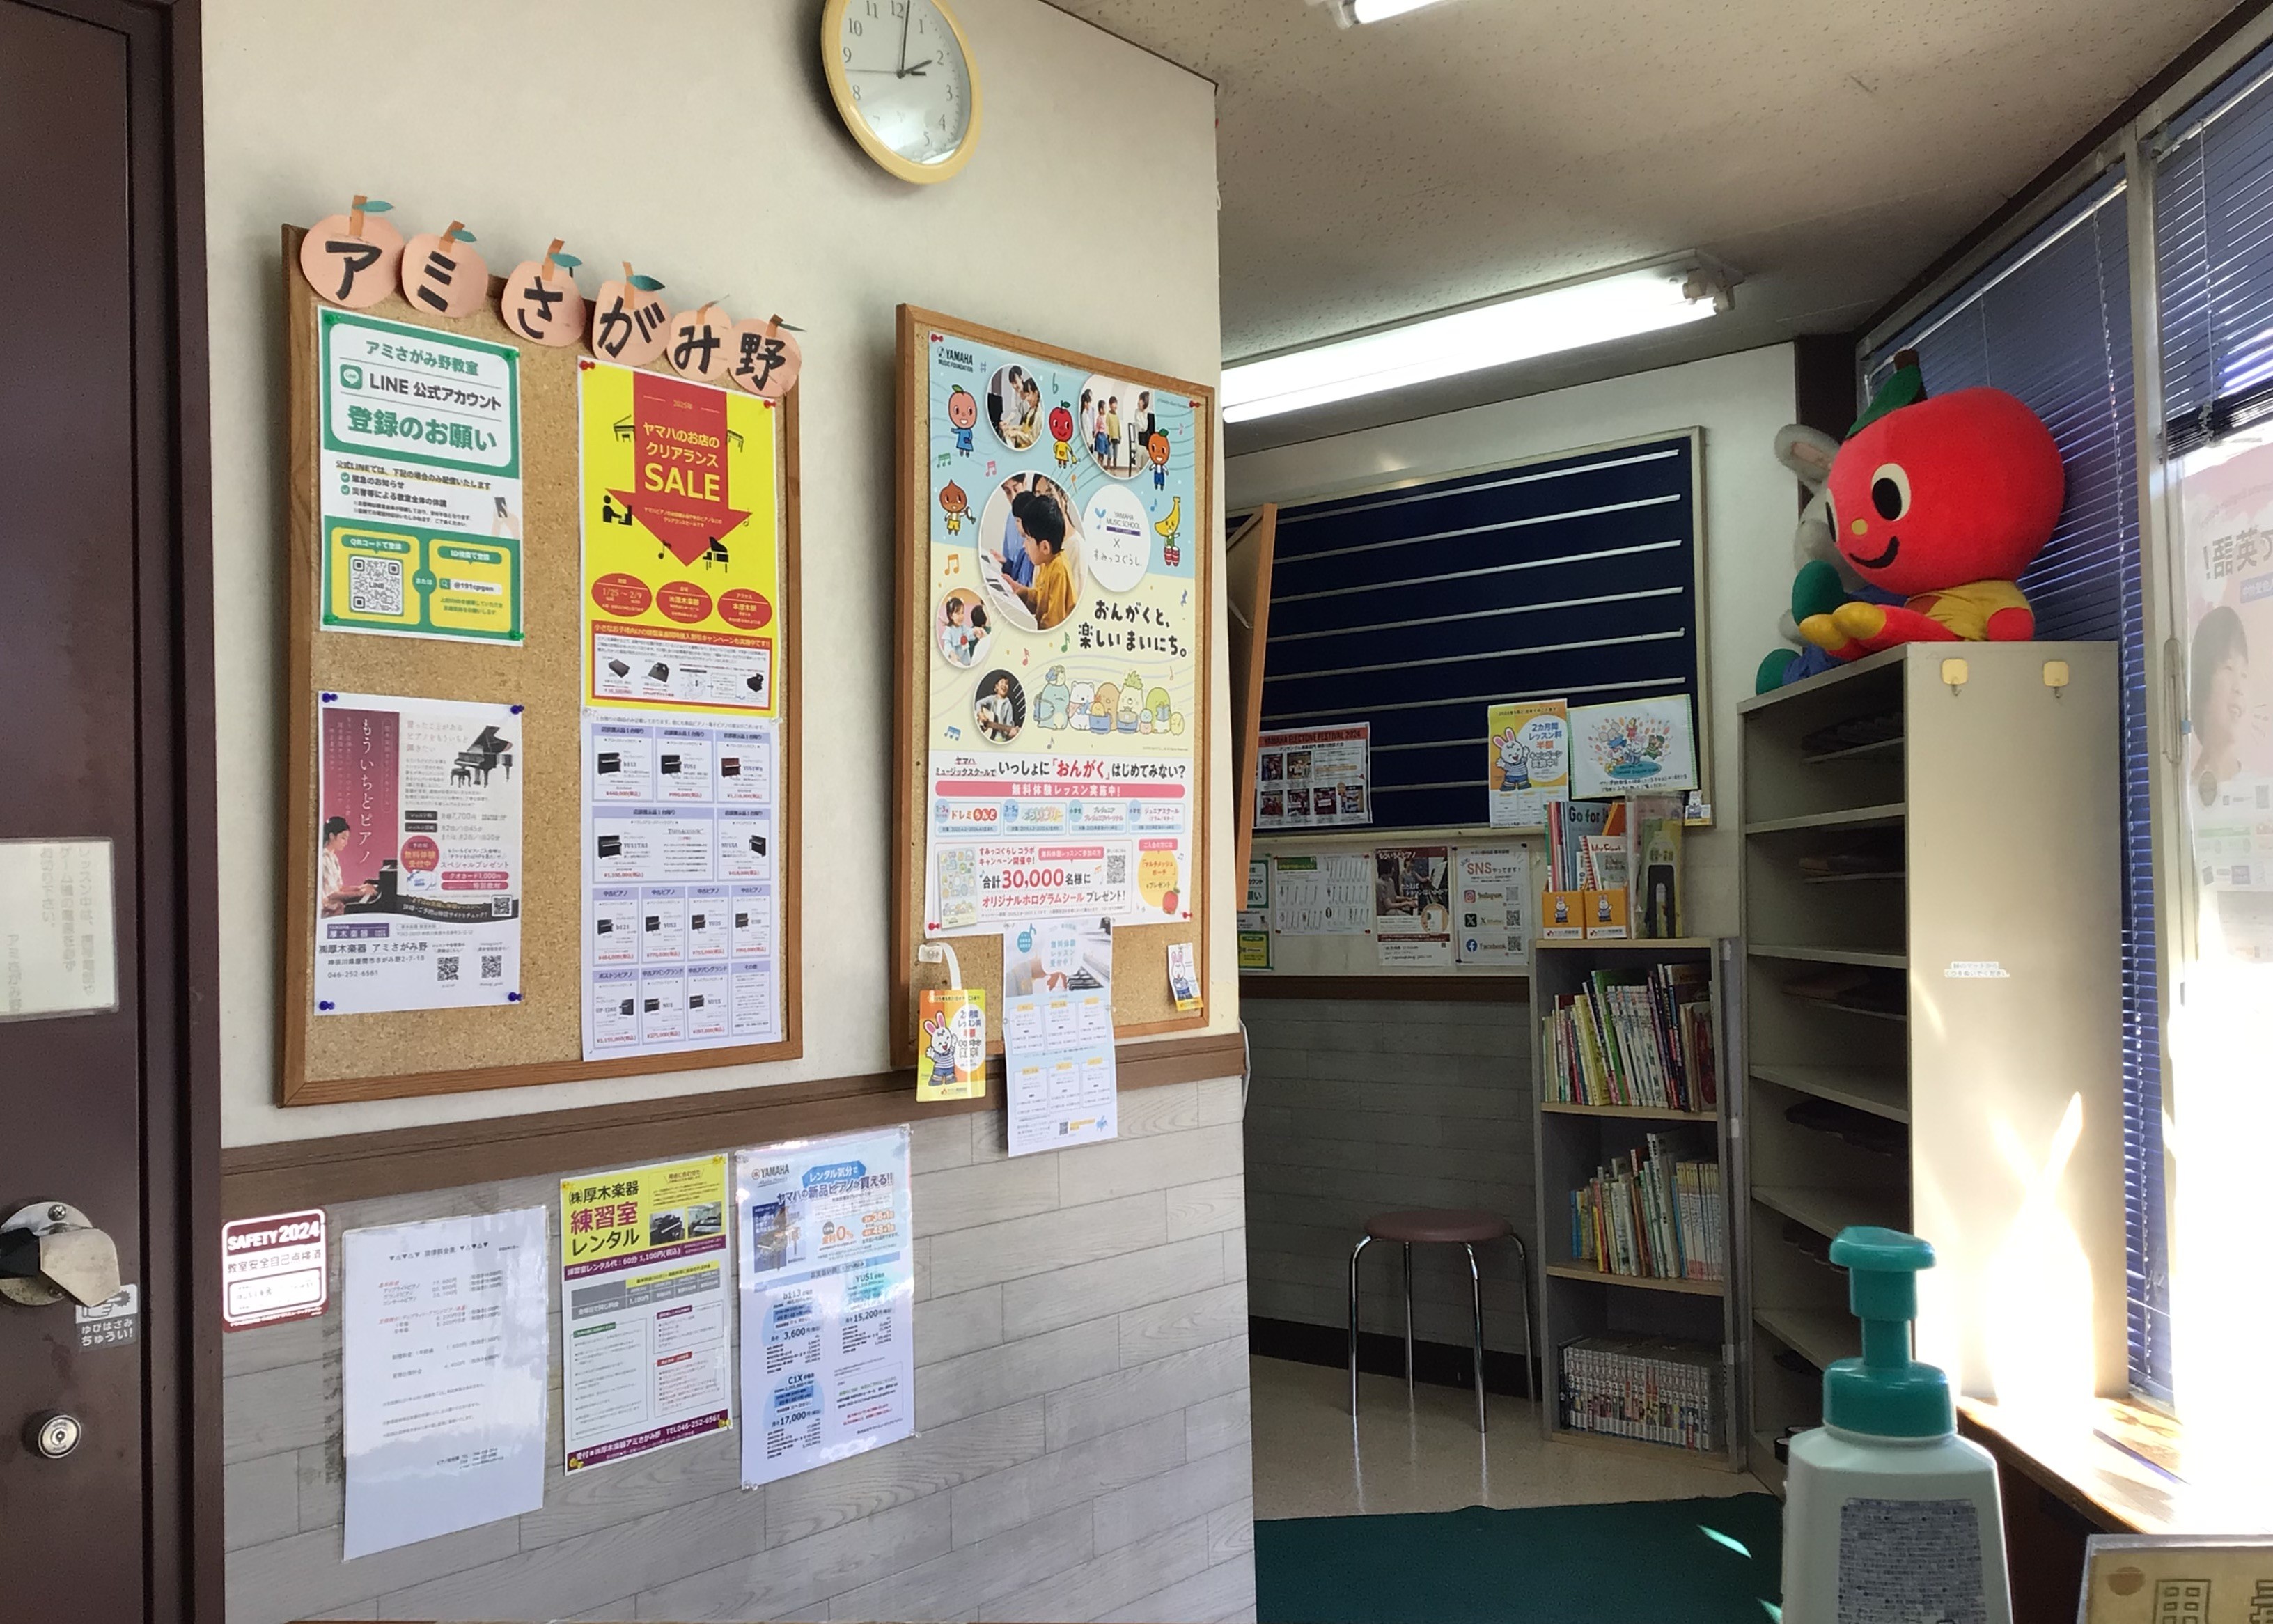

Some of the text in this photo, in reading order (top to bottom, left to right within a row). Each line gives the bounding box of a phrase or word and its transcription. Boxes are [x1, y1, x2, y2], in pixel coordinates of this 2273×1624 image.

[866, 0, 878, 19] 11
[849, 18, 863, 36] 10
[919, 19, 924, 34] 1
[843, 47, 852, 63] 9
[937, 50, 944, 65] 2
[853, 85, 861, 101] 8
[946, 85, 953, 101] 3
[939, 114, 946, 131] 4
[923, 132, 930, 146] 5
[325, 240, 786, 391] アミさがみ野
[366, 340, 478, 376] アミさがみ野教室
[938, 359, 951, 367] MUSIC
[946, 348, 974, 366] YAMAHA
[370, 373, 501, 411] LINE 公式アカウント
[347, 405, 497, 452] 登録のお願い
[643, 422, 720, 448] ヤマハのお店の
[646, 442, 719, 469] クリアランス
[644, 462, 720, 501] SALE
[1106, 518, 1141, 530] MUSIC SCHOOL
[1114, 511, 1134, 521] YAMAHA
[1093, 548, 1141, 567] すみっコぐらし
[1094, 599, 1171, 628] おんがくと、
[1078, 621, 1187, 657] 楽しい まいにち。
[1531, 721, 1559, 732] 2カ月間
[1529, 731, 1563, 740] レッスン料
[1536, 740, 1554, 750] 半額
[955, 756, 977, 765] ヤマハ
[935, 767, 997, 779] ミュージックスクールで
[359, 718, 375, 864] もういちどピアノ
[1011, 783, 1121, 797] 無料体験レッスン実施中!
[951, 807, 998, 822] ドレミらんど
[1569, 806, 1600, 823] Go for
[978, 846, 1036, 856] すみっコぐらし コラボ
[440, 861, 510, 869] スペシャルプレゼント
[978, 856, 1036, 866] キャンペーン開催中!
[982, 868, 1091, 890] 合計30,000名様に
[982, 890, 1125, 908] オリジナルホログラムシール プレゼント!
[373, 942, 428, 953] アミさがみ野
[327, 969, 379, 978] 046-252-6561
[760, 1164, 790, 1179] YAMAHA
[809, 1166, 859, 1182] レンタル気分で
[570, 1201, 639, 1235] 練習室
[228, 1221, 320, 1251] SAFETY 2024
[572, 1228, 640, 1257] レンタル
[81, 1318, 132, 1335] ゆびはさみ
[81, 1327, 133, 1346] ちゅうい!
[788, 1373, 803, 1384] C1X
